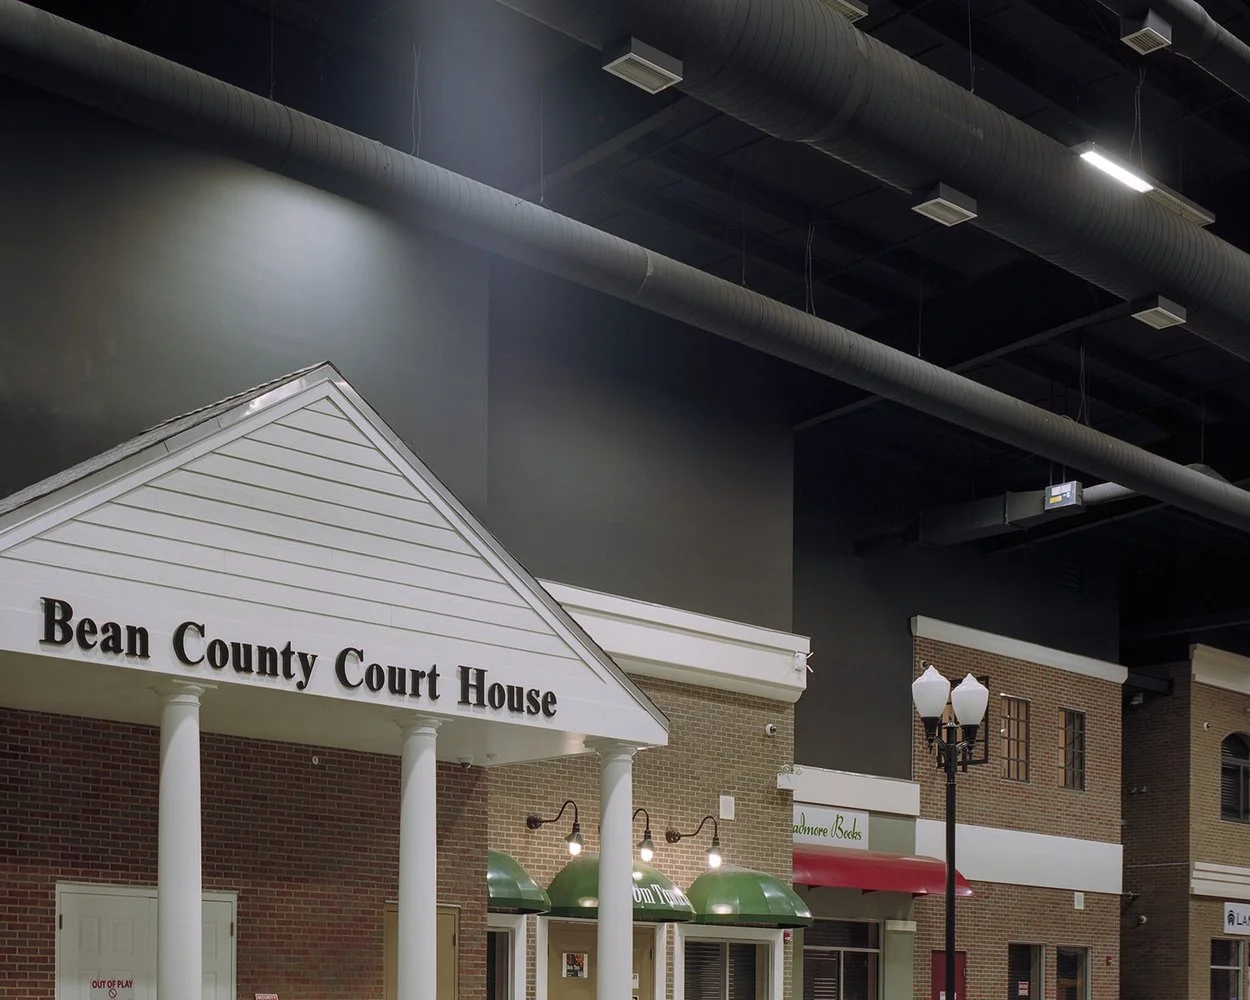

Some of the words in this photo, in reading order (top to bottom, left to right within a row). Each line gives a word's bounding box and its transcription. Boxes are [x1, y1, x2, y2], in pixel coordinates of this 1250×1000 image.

[39, 596, 150, 658] Bean
[173, 621, 318, 690] County
[335, 646, 440, 700] Court
[457, 664, 557, 717] House
[793, 812, 828, 837] admore
[831, 814, 862, 841] Books
[91, 980, 106, 989] OUT
[106, 980, 116, 989] OF
[117, 980, 133, 989] PLAY
